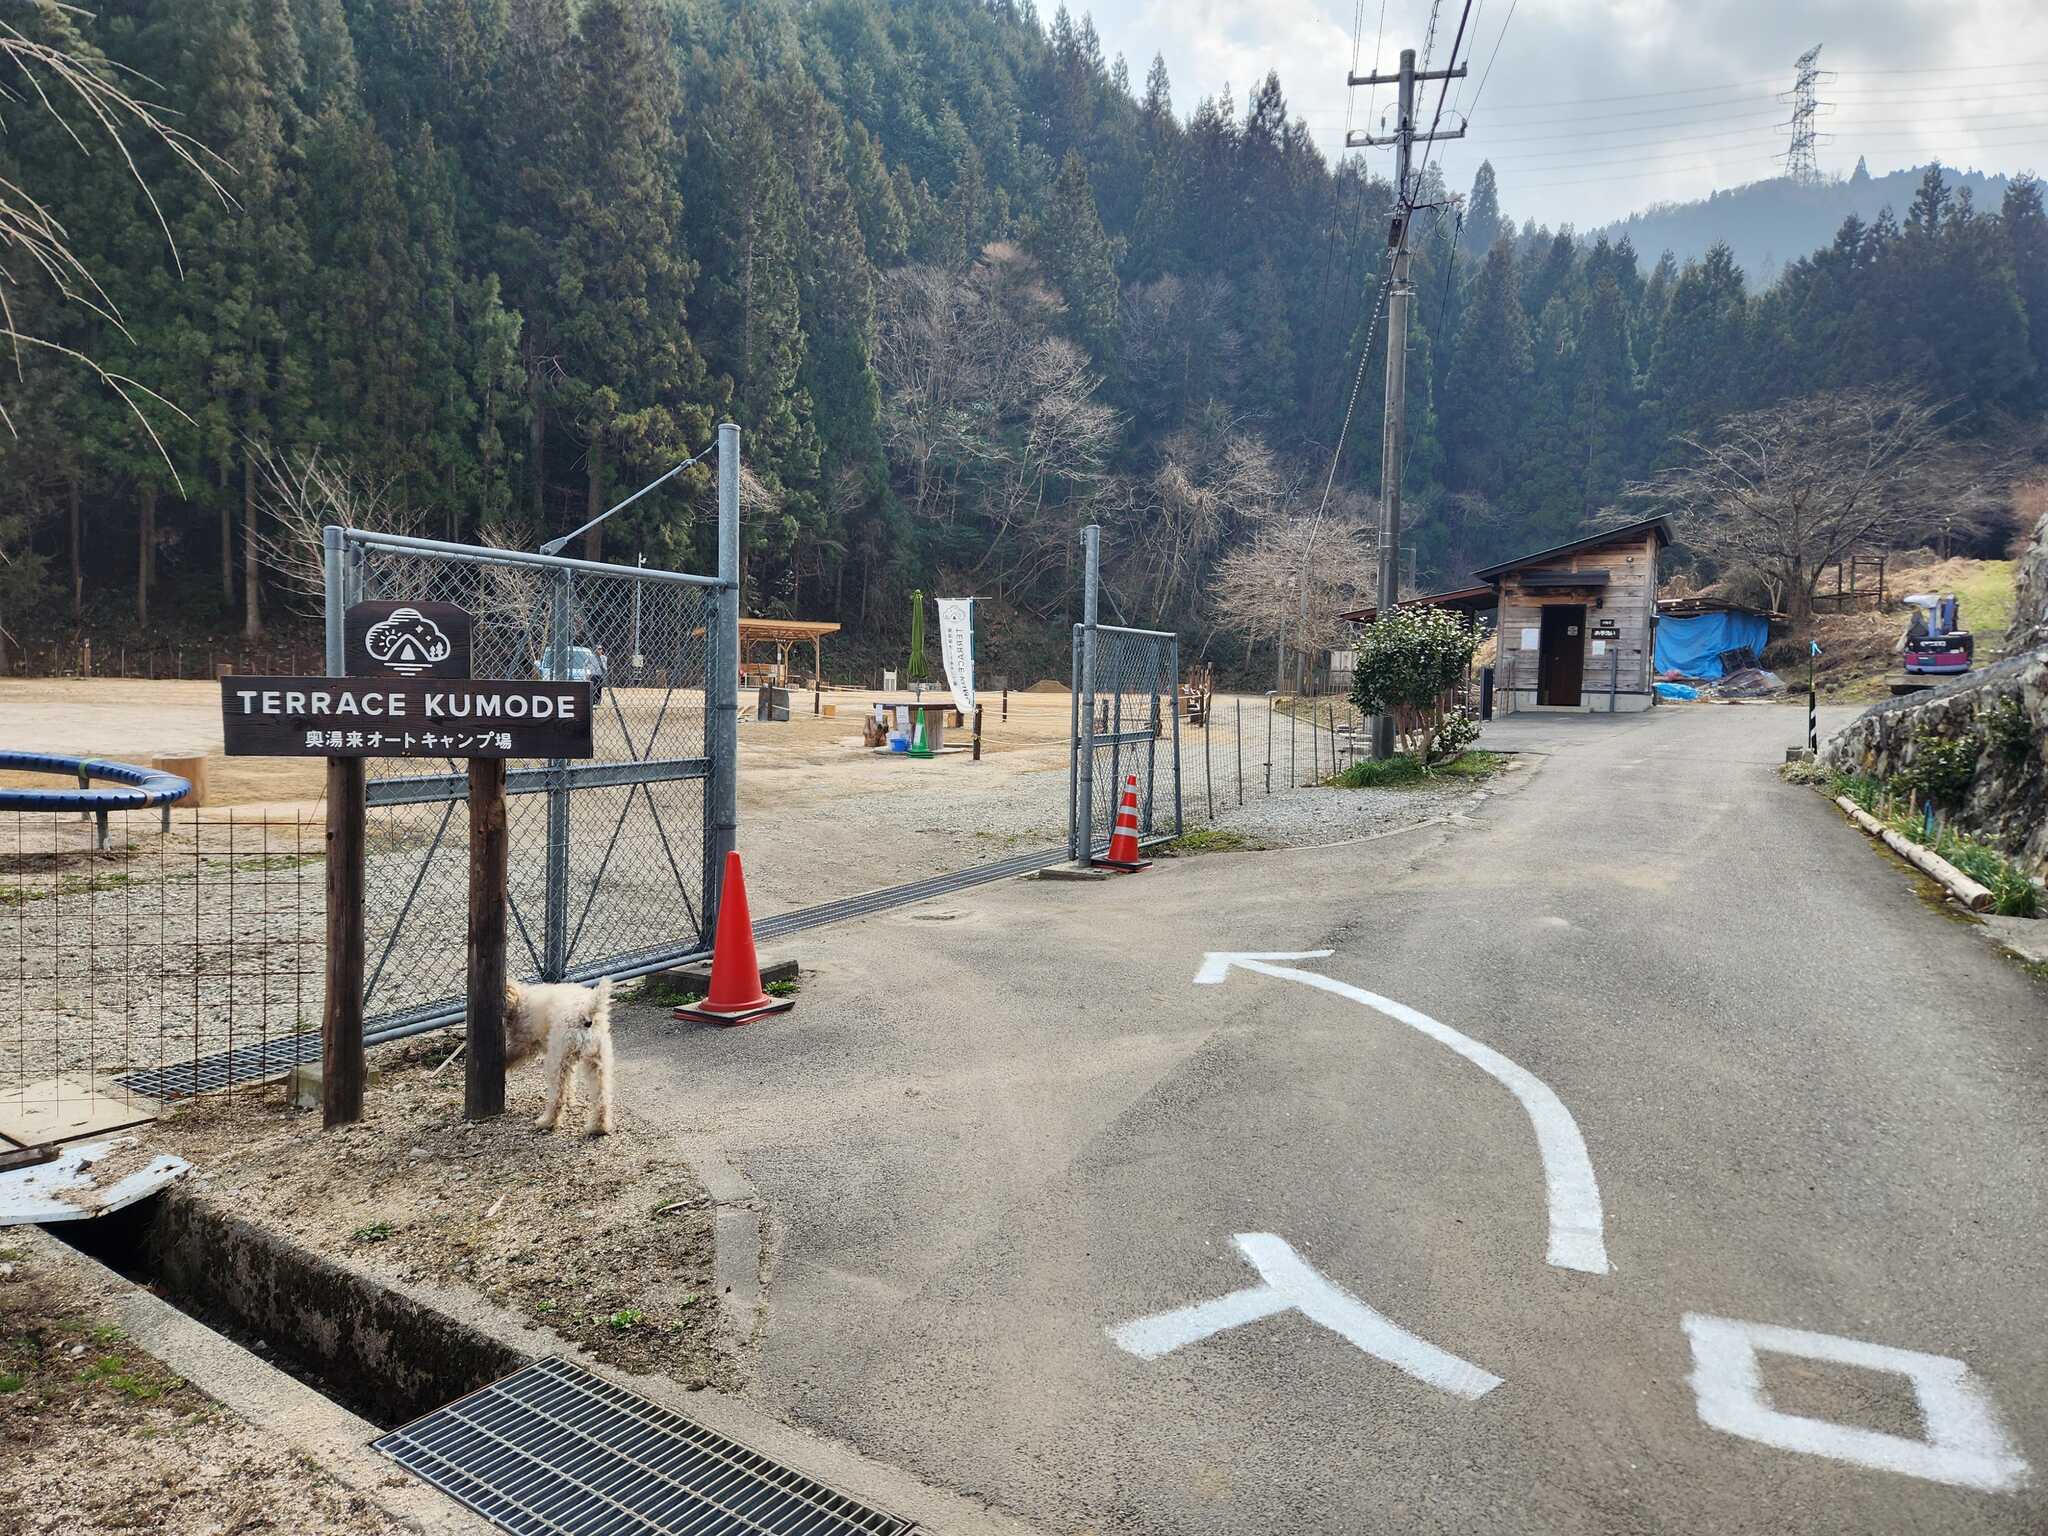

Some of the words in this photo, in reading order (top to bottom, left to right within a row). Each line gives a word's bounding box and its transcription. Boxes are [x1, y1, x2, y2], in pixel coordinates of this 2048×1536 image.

[236, 690, 406, 716] TERRACE
[425, 693, 575, 719] KUMODE
[305, 730, 512, 750] 奥湯来オートキャンプ場
[1107, 1231, 2029, 1493] 入口
